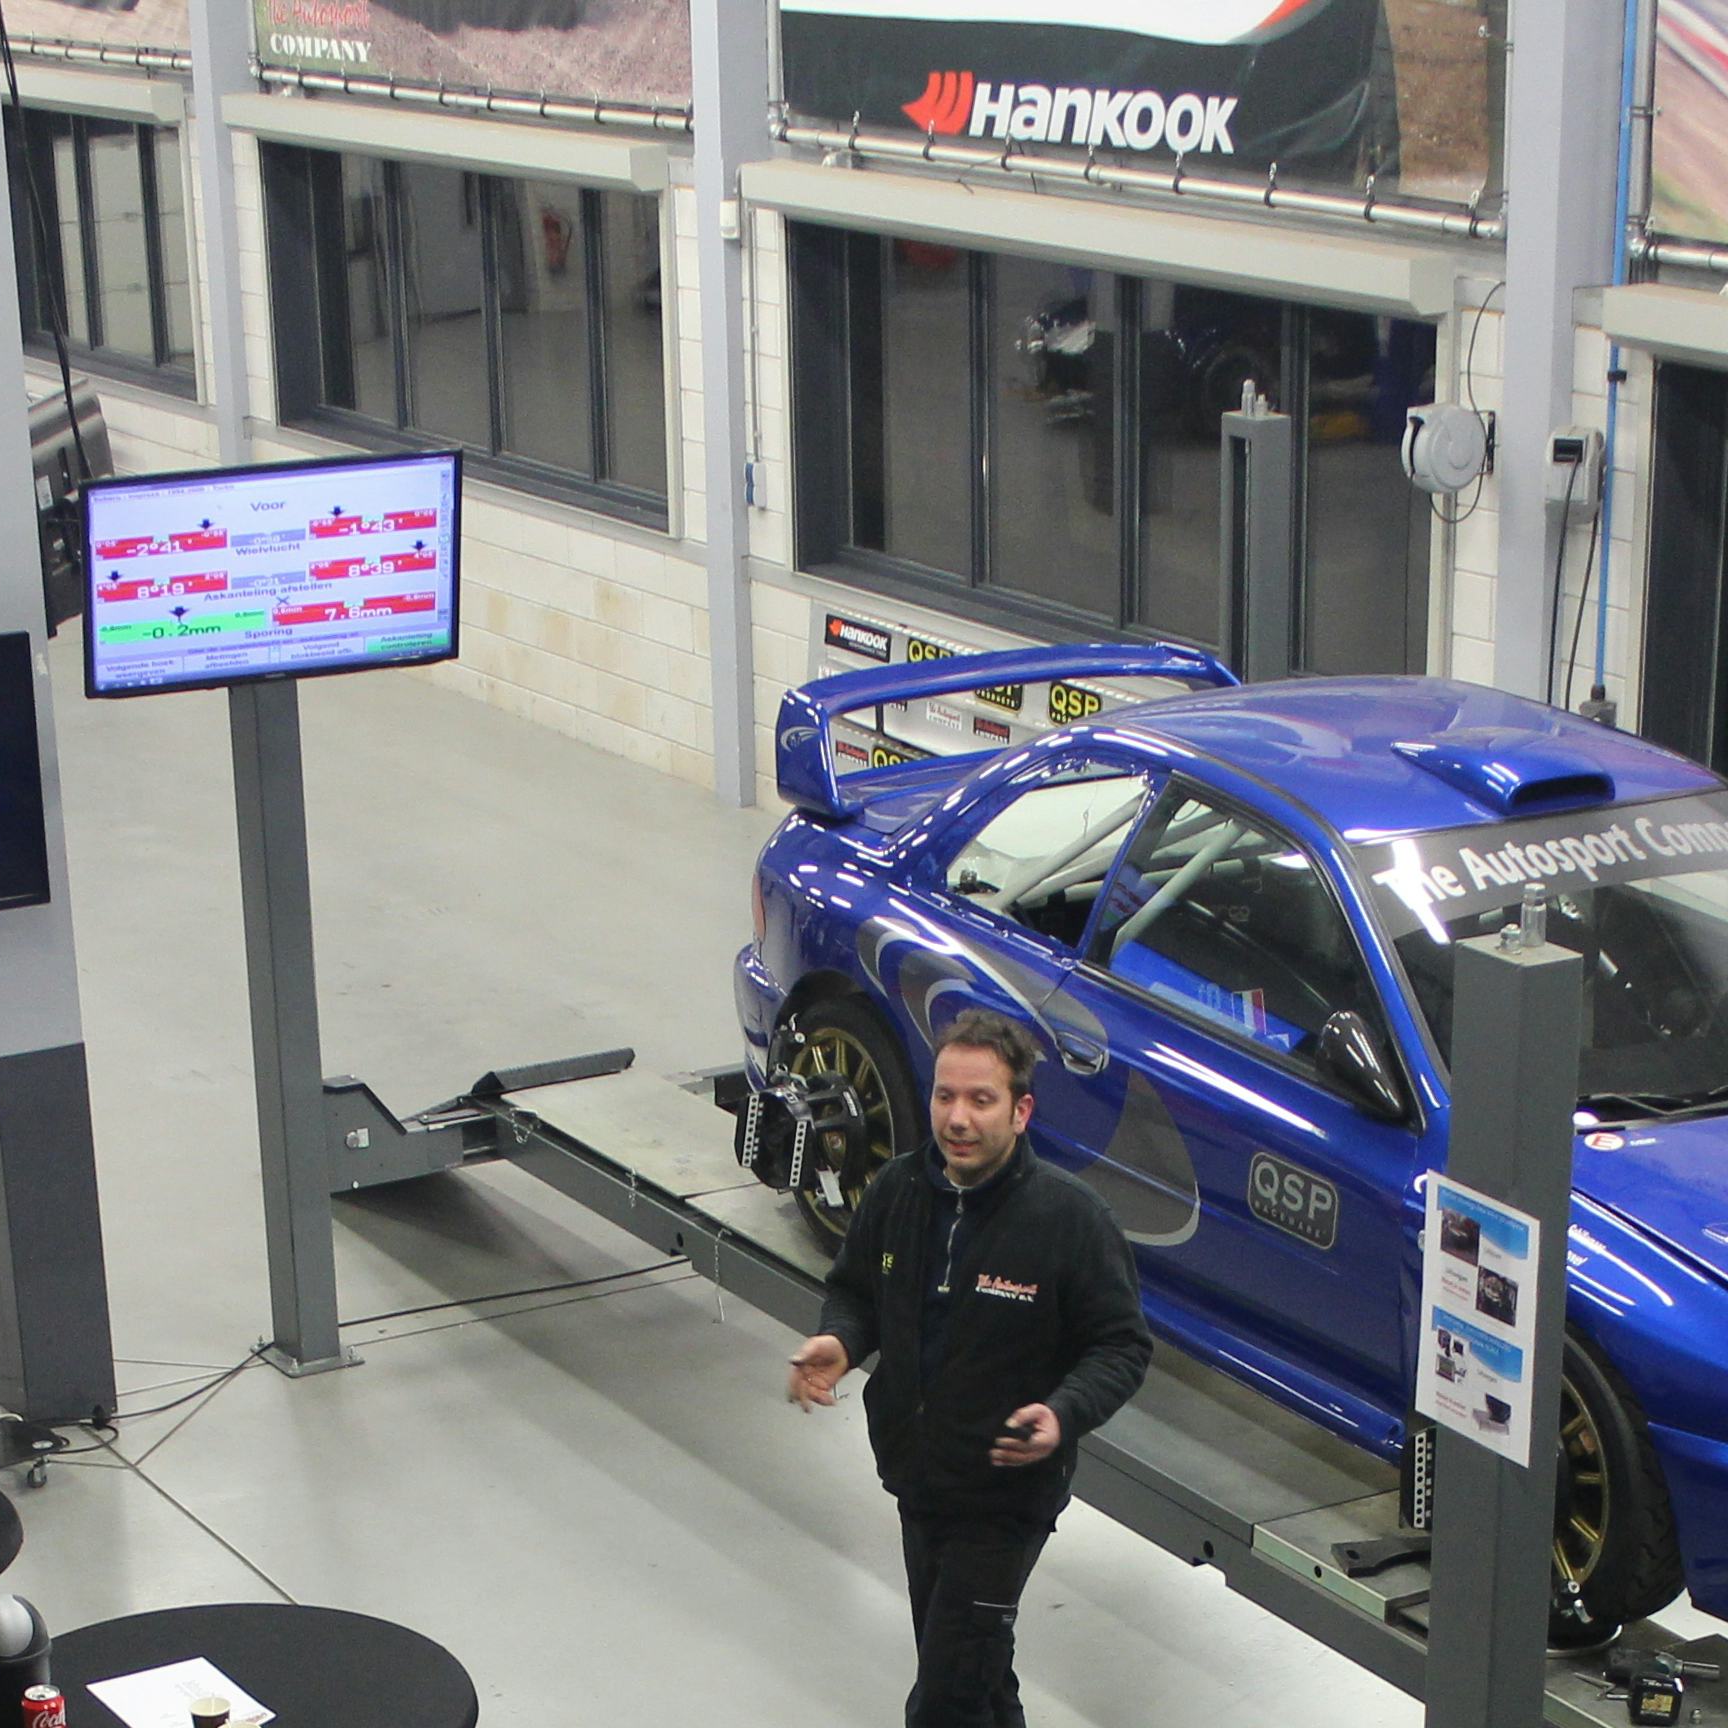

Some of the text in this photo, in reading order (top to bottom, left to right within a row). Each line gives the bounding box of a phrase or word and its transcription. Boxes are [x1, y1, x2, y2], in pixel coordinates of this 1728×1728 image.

[270, 33, 372, 63] COMPANY
[250, 500, 286, 512] Voor
[235, 542, 301, 557] Wielvlucht
[203, 579, 333, 603] Askanteling afstellen
[244, 626, 293, 641] Sporing
[1051, 685, 1100, 717] QSP
[1458, 823, 1648, 891] Autosport
[1253, 1161, 1333, 1220] QSP
